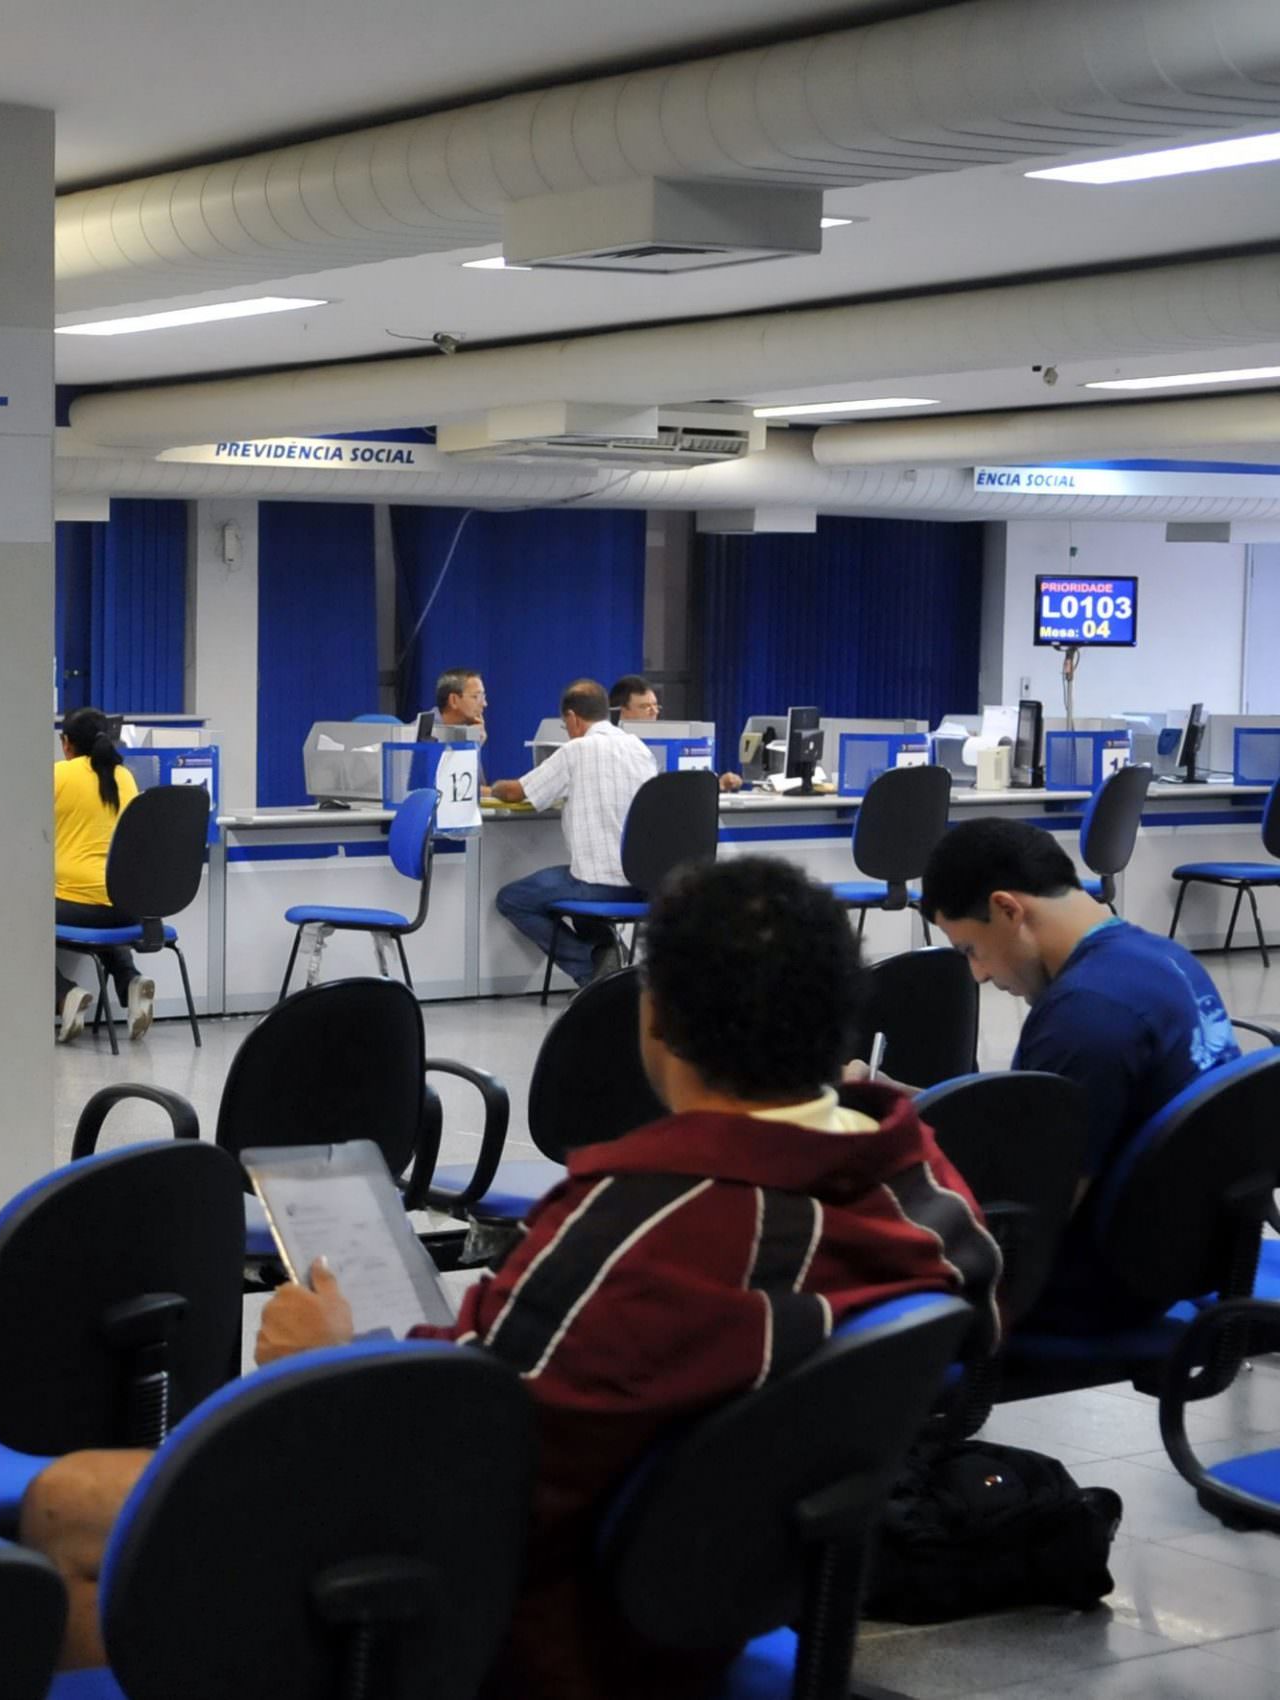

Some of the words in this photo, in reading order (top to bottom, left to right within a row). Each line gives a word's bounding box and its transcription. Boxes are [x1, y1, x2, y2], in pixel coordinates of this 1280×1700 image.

[215, 441, 344, 461] PREVIDÊNCIA
[350, 447, 415, 464] SOCIAL
[976, 469, 1021, 486] ÊNCIA
[1025, 474, 1075, 487] SOCIAL
[1040, 582, 1113, 593] PRIORIDADE
[1042, 595, 1132, 619] L0103
[1040, 626, 1079, 638] Mesa:
[1082, 619, 1111, 638] 04
[450, 771, 473, 803] 12
